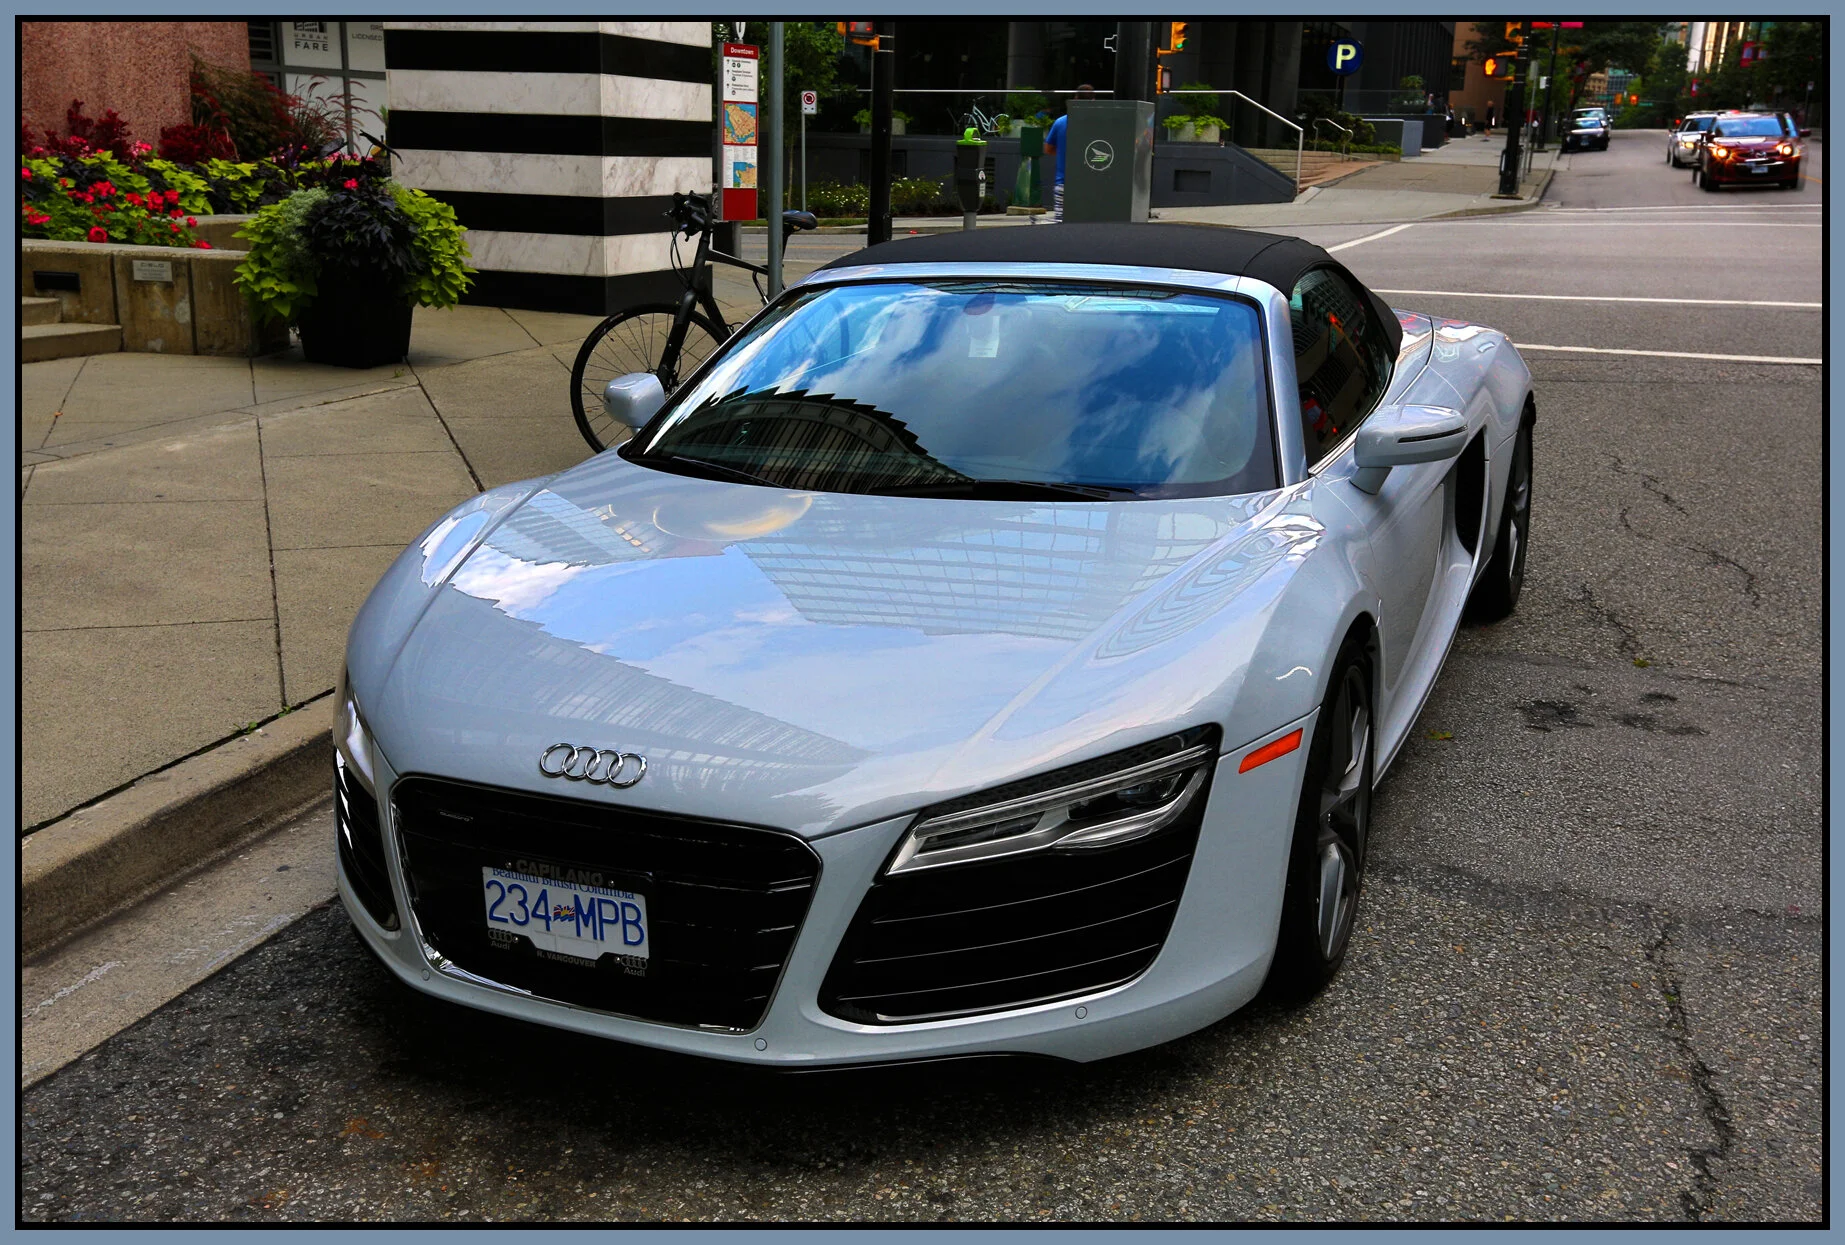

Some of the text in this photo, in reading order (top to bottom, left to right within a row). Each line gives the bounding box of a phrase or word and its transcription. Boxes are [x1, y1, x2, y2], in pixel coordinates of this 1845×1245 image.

[294, 41, 329, 51] FARE
[730, 47, 754, 55] Downtown
[1336, 44, 1356, 69] P
[516, 859, 604, 886] CAPILANO
[486, 879, 645, 946] 234 MPB
[490, 940, 511, 950] Audi
[547, 952, 596, 968] VANCOUVER
[624, 966, 646, 977] Audi
